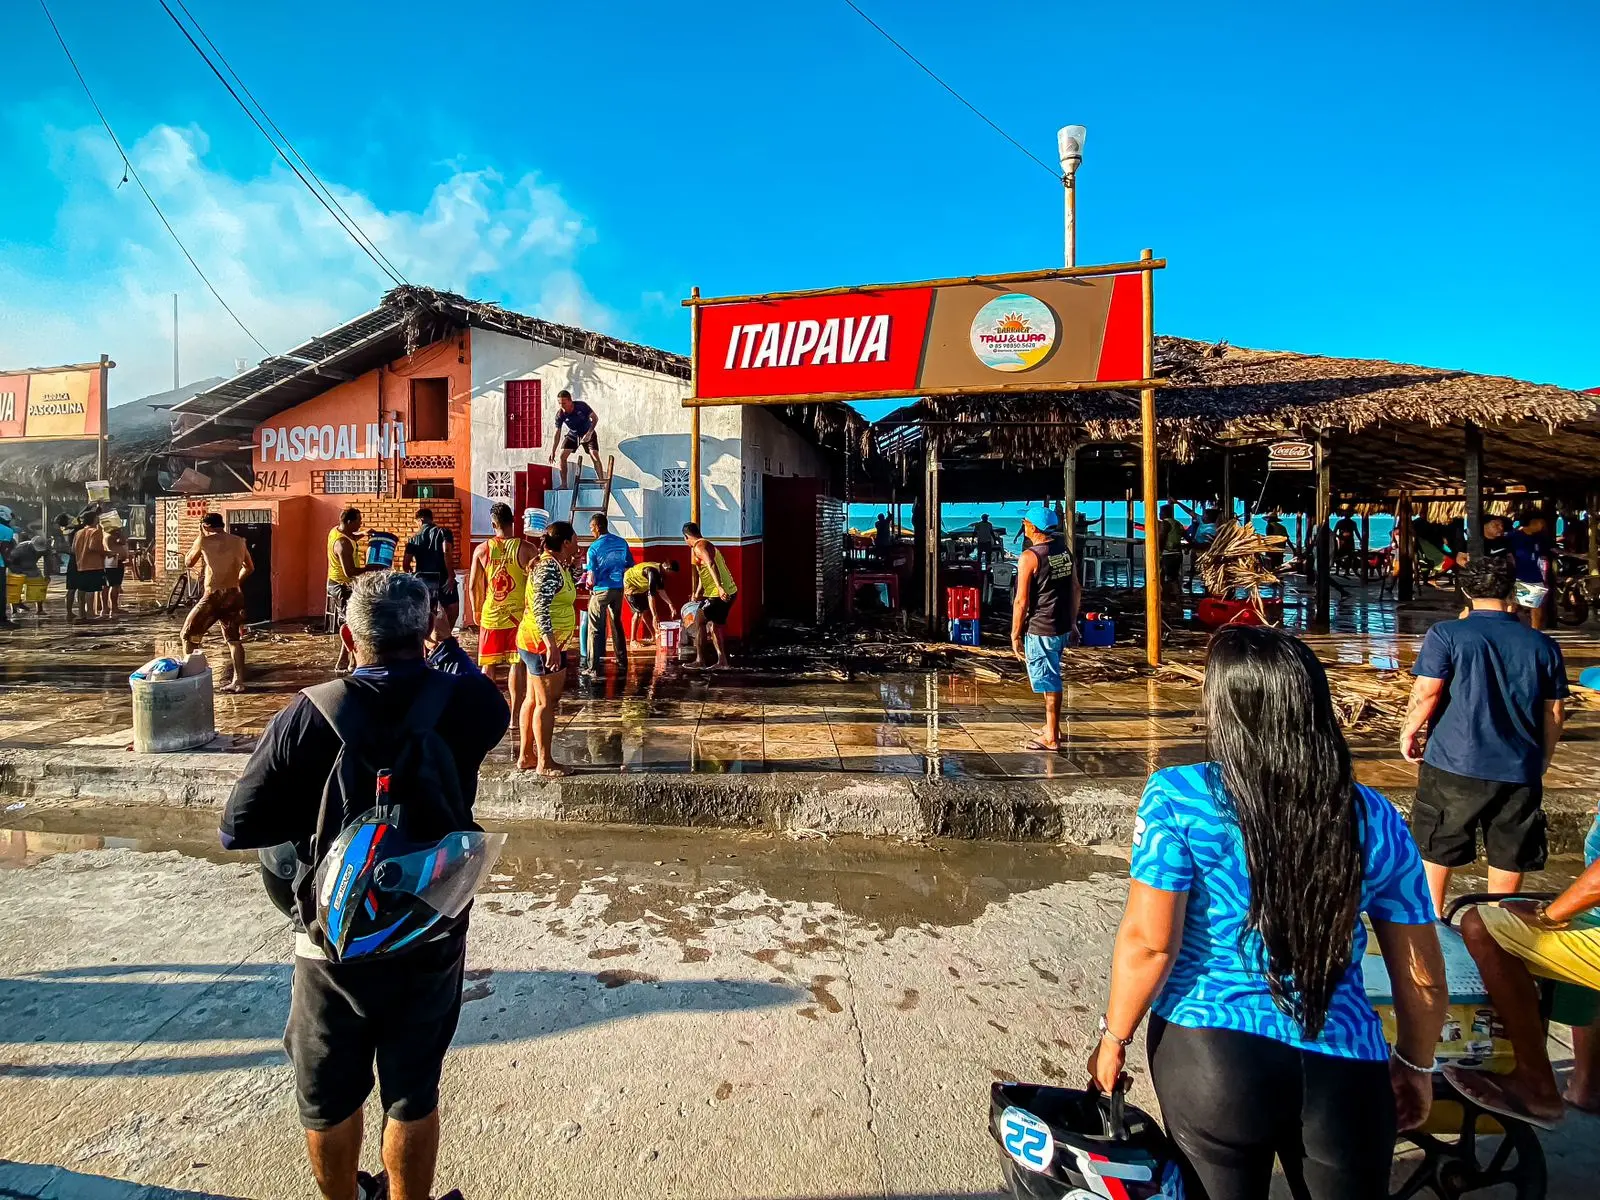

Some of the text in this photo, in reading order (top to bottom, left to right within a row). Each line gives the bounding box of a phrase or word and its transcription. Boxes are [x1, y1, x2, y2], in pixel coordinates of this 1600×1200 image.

[724, 315, 890, 370] ITAIPAVA
[29, 403, 84, 416] PASCOALINA
[261, 422, 406, 462] PASCOALINA
[254, 469, 290, 492] 5144
[1006, 1120, 1047, 1165] 22
